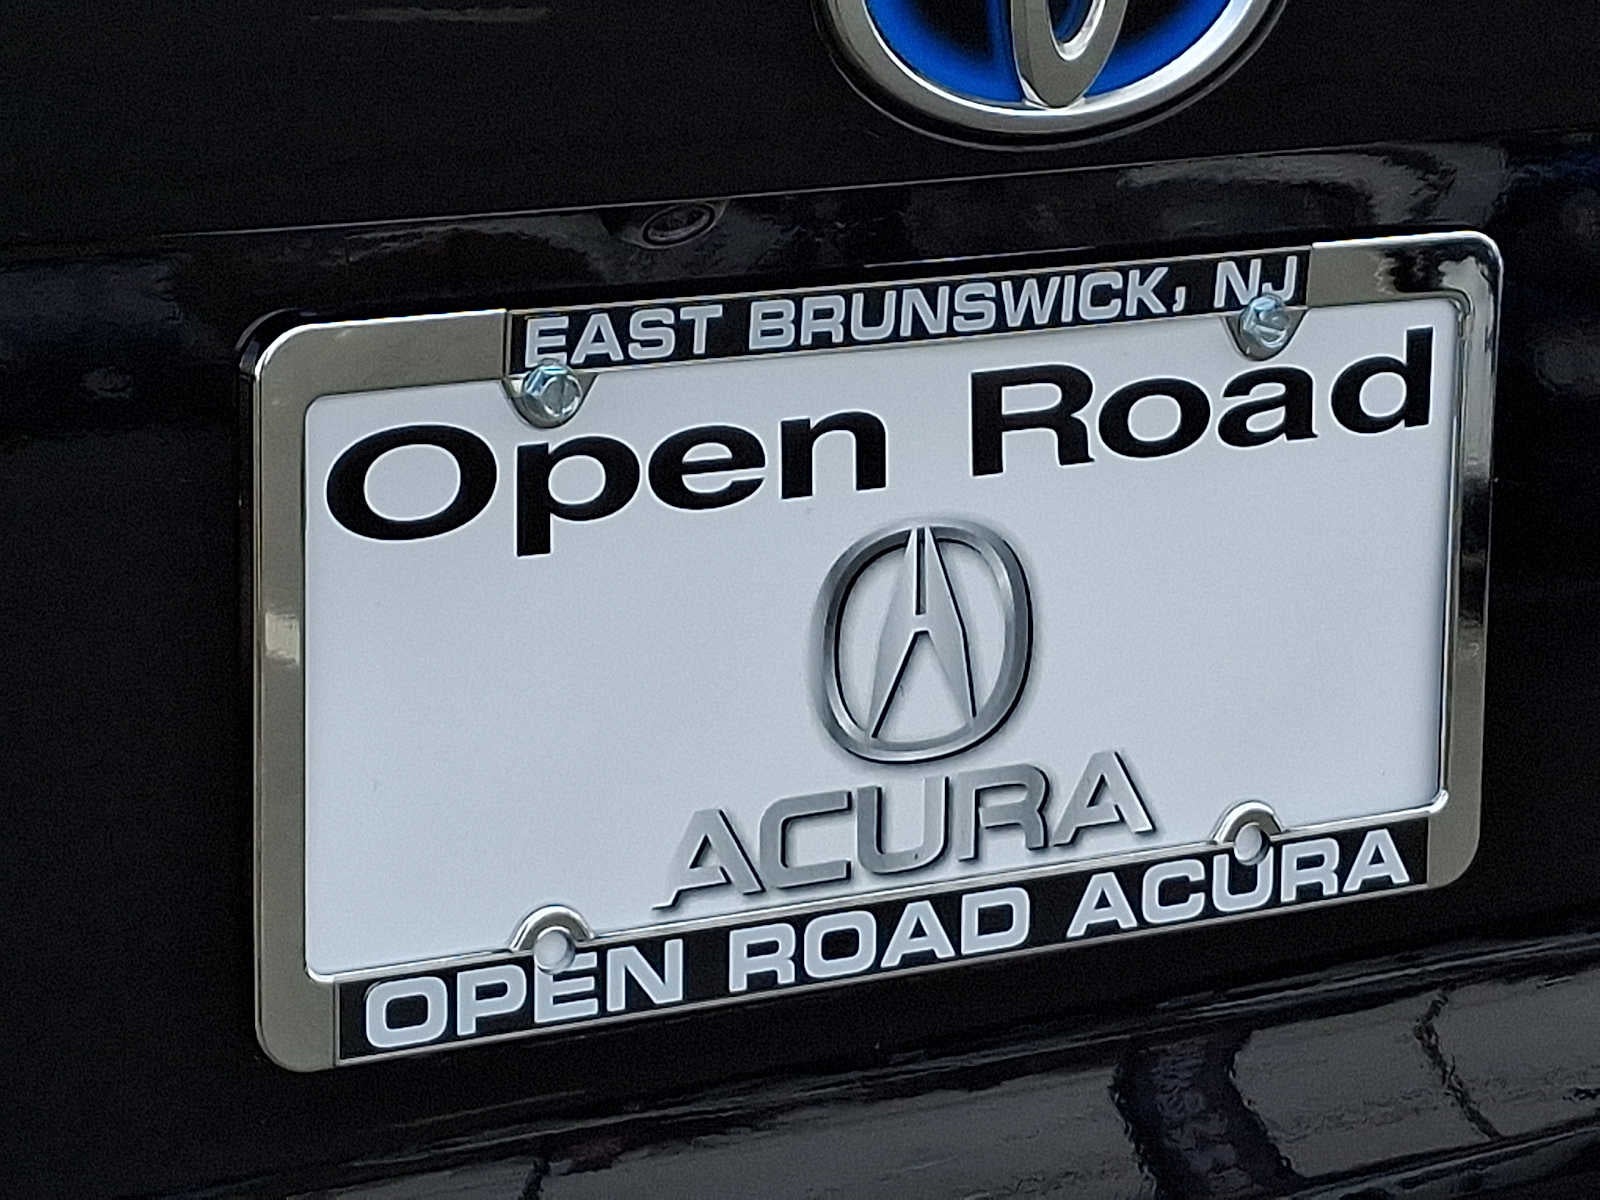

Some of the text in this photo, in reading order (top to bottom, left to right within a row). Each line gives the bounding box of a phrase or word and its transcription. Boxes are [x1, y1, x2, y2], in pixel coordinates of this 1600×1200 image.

[525, 255, 1298, 369] EAST BRUNSWICK, NJ
[325, 325, 1435, 558] Open Road
[652, 749, 1157, 911] ACURA
[365, 828, 1410, 1049] OPEN ROAD ACURA
